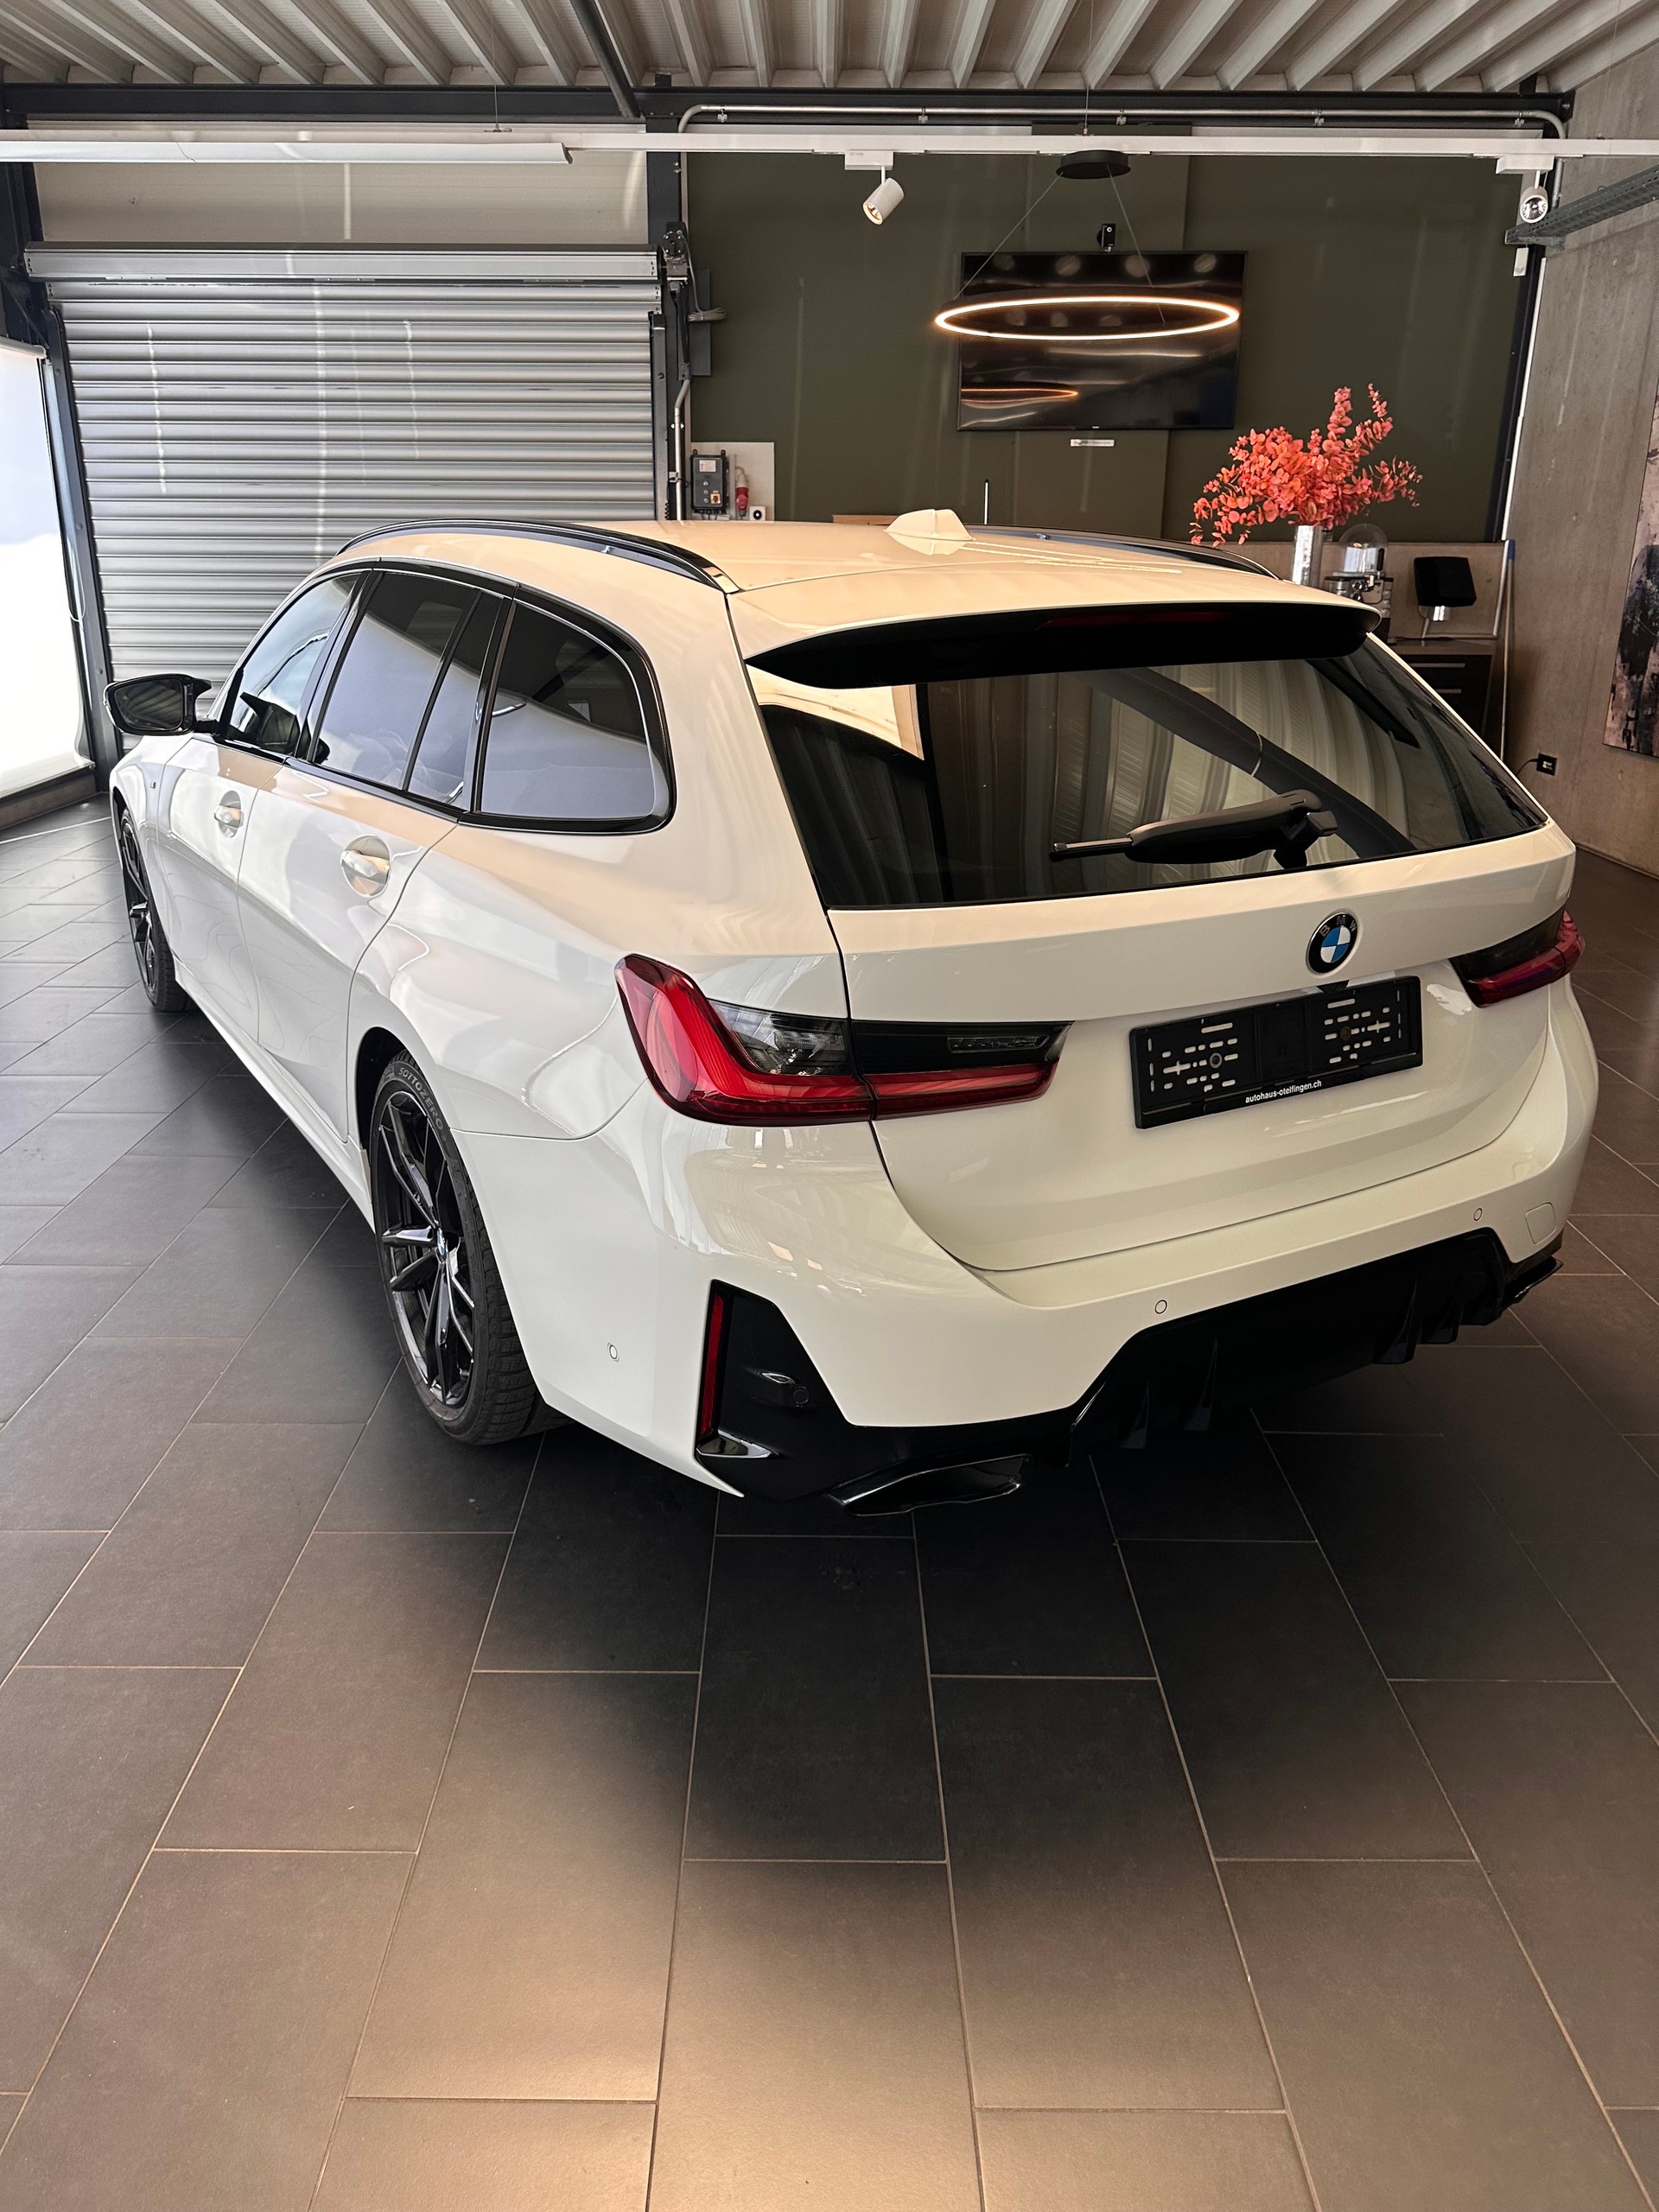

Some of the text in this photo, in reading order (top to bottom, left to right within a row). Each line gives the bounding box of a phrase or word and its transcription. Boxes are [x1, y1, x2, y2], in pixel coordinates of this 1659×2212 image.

[1319, 915, 1357, 937] BMW
[398, 1067, 444, 1130] SOTTOZERO
[1245, 1079, 1322, 1103] autohaus-otelfingen.ch
